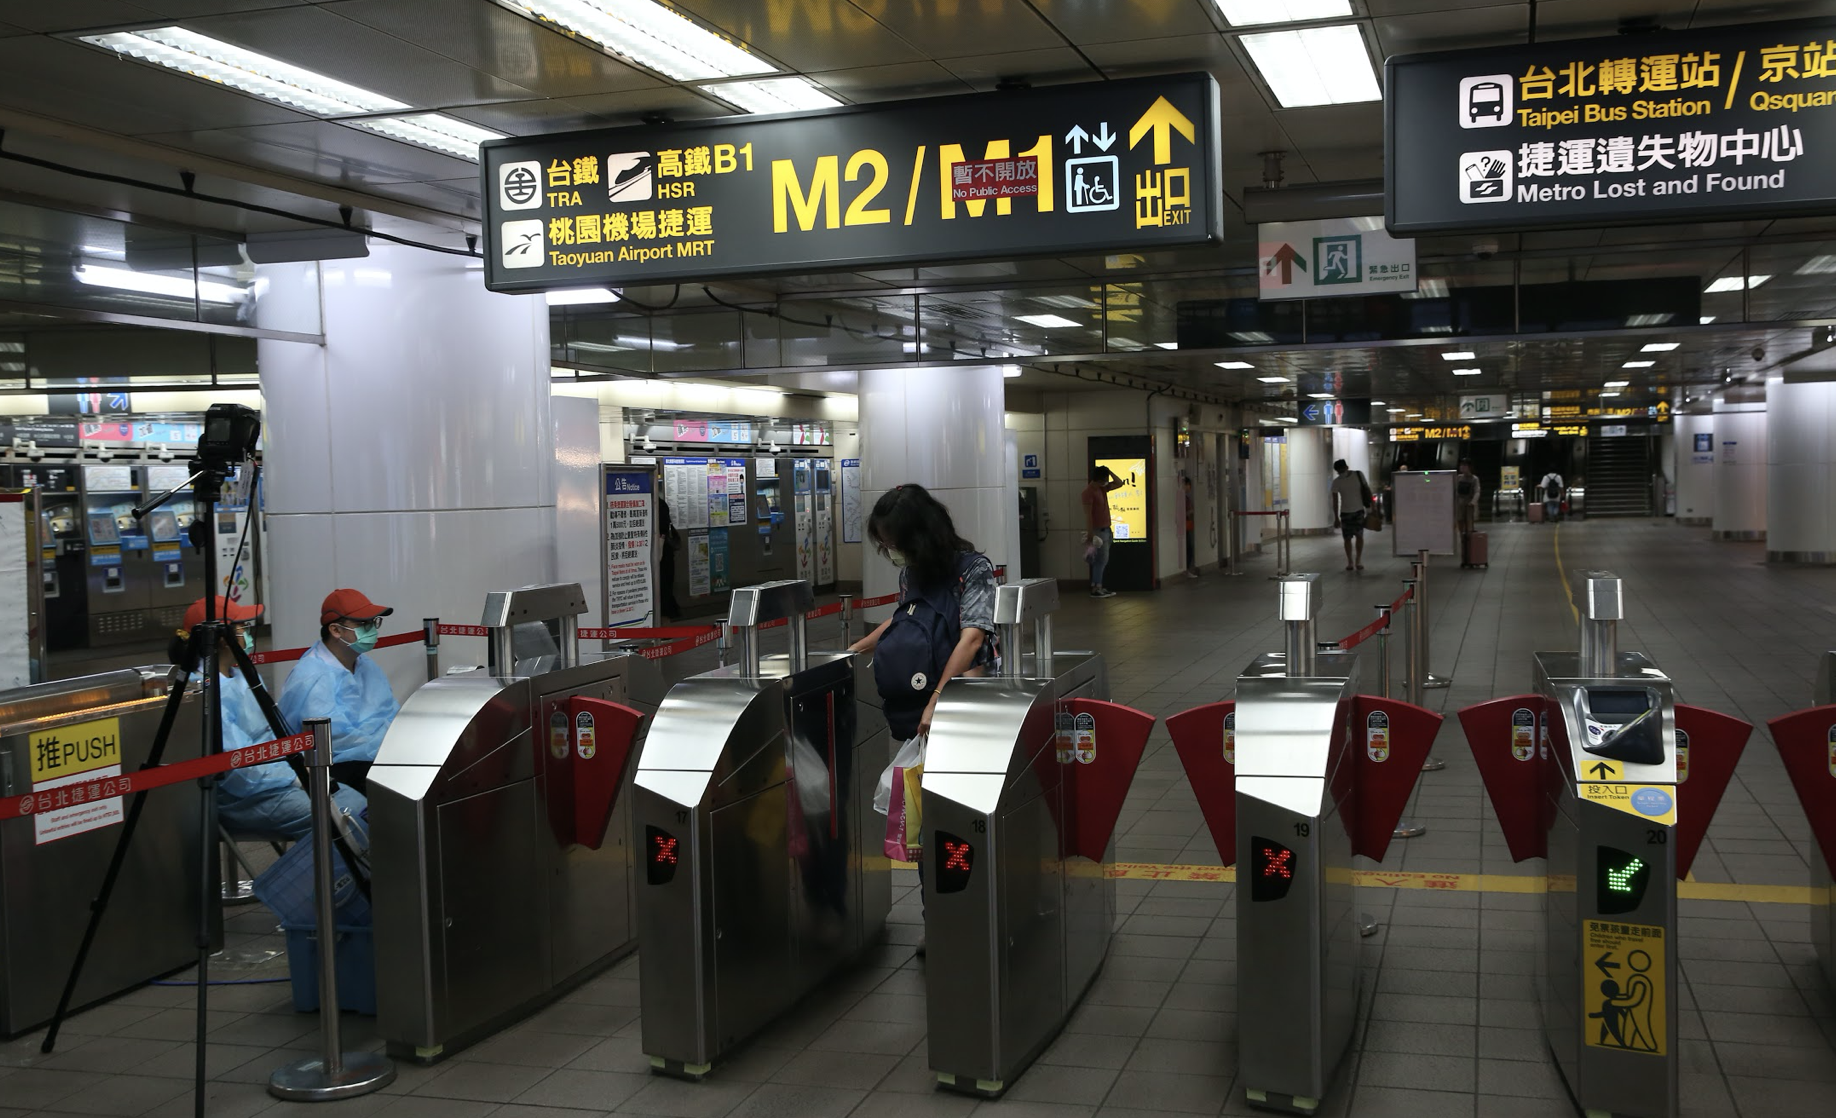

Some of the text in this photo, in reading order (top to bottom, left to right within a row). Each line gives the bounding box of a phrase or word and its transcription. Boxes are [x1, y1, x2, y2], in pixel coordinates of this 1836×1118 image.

[1518, 51, 1720, 102] 台北轉運站
[1517, 105, 1579, 129] Taipei
[1584, 102, 1627, 123] Bus
[1631, 98, 1711, 120] Station
[1517, 124, 1804, 178] 捷運遺失物中心
[546, 155, 600, 187] 台鐵
[953, 160, 1037, 185] 暫不開放
[547, 190, 583, 208] TRA
[657, 182, 695, 199] HSR
[953, 184, 1037, 198] No Public Access
[1135, 167, 1191, 229] 出口
[1517, 169, 1785, 203] Metro Lost and Found
[548, 205, 714, 246] 桃園機場捷運
[1163, 209, 1192, 226] EXIT
[549, 240, 715, 268] Taoyuan Airport MRT
[243, 734, 315, 765] 台北捷運公司
[38, 777, 132, 811] 台北捷運公司
[1588, 785, 1628, 795] 投入口
[676, 811, 688, 825] 17
[972, 820, 987, 834] 18
[1293, 822, 1310, 838] 19
[1647, 829, 1667, 845] 20
